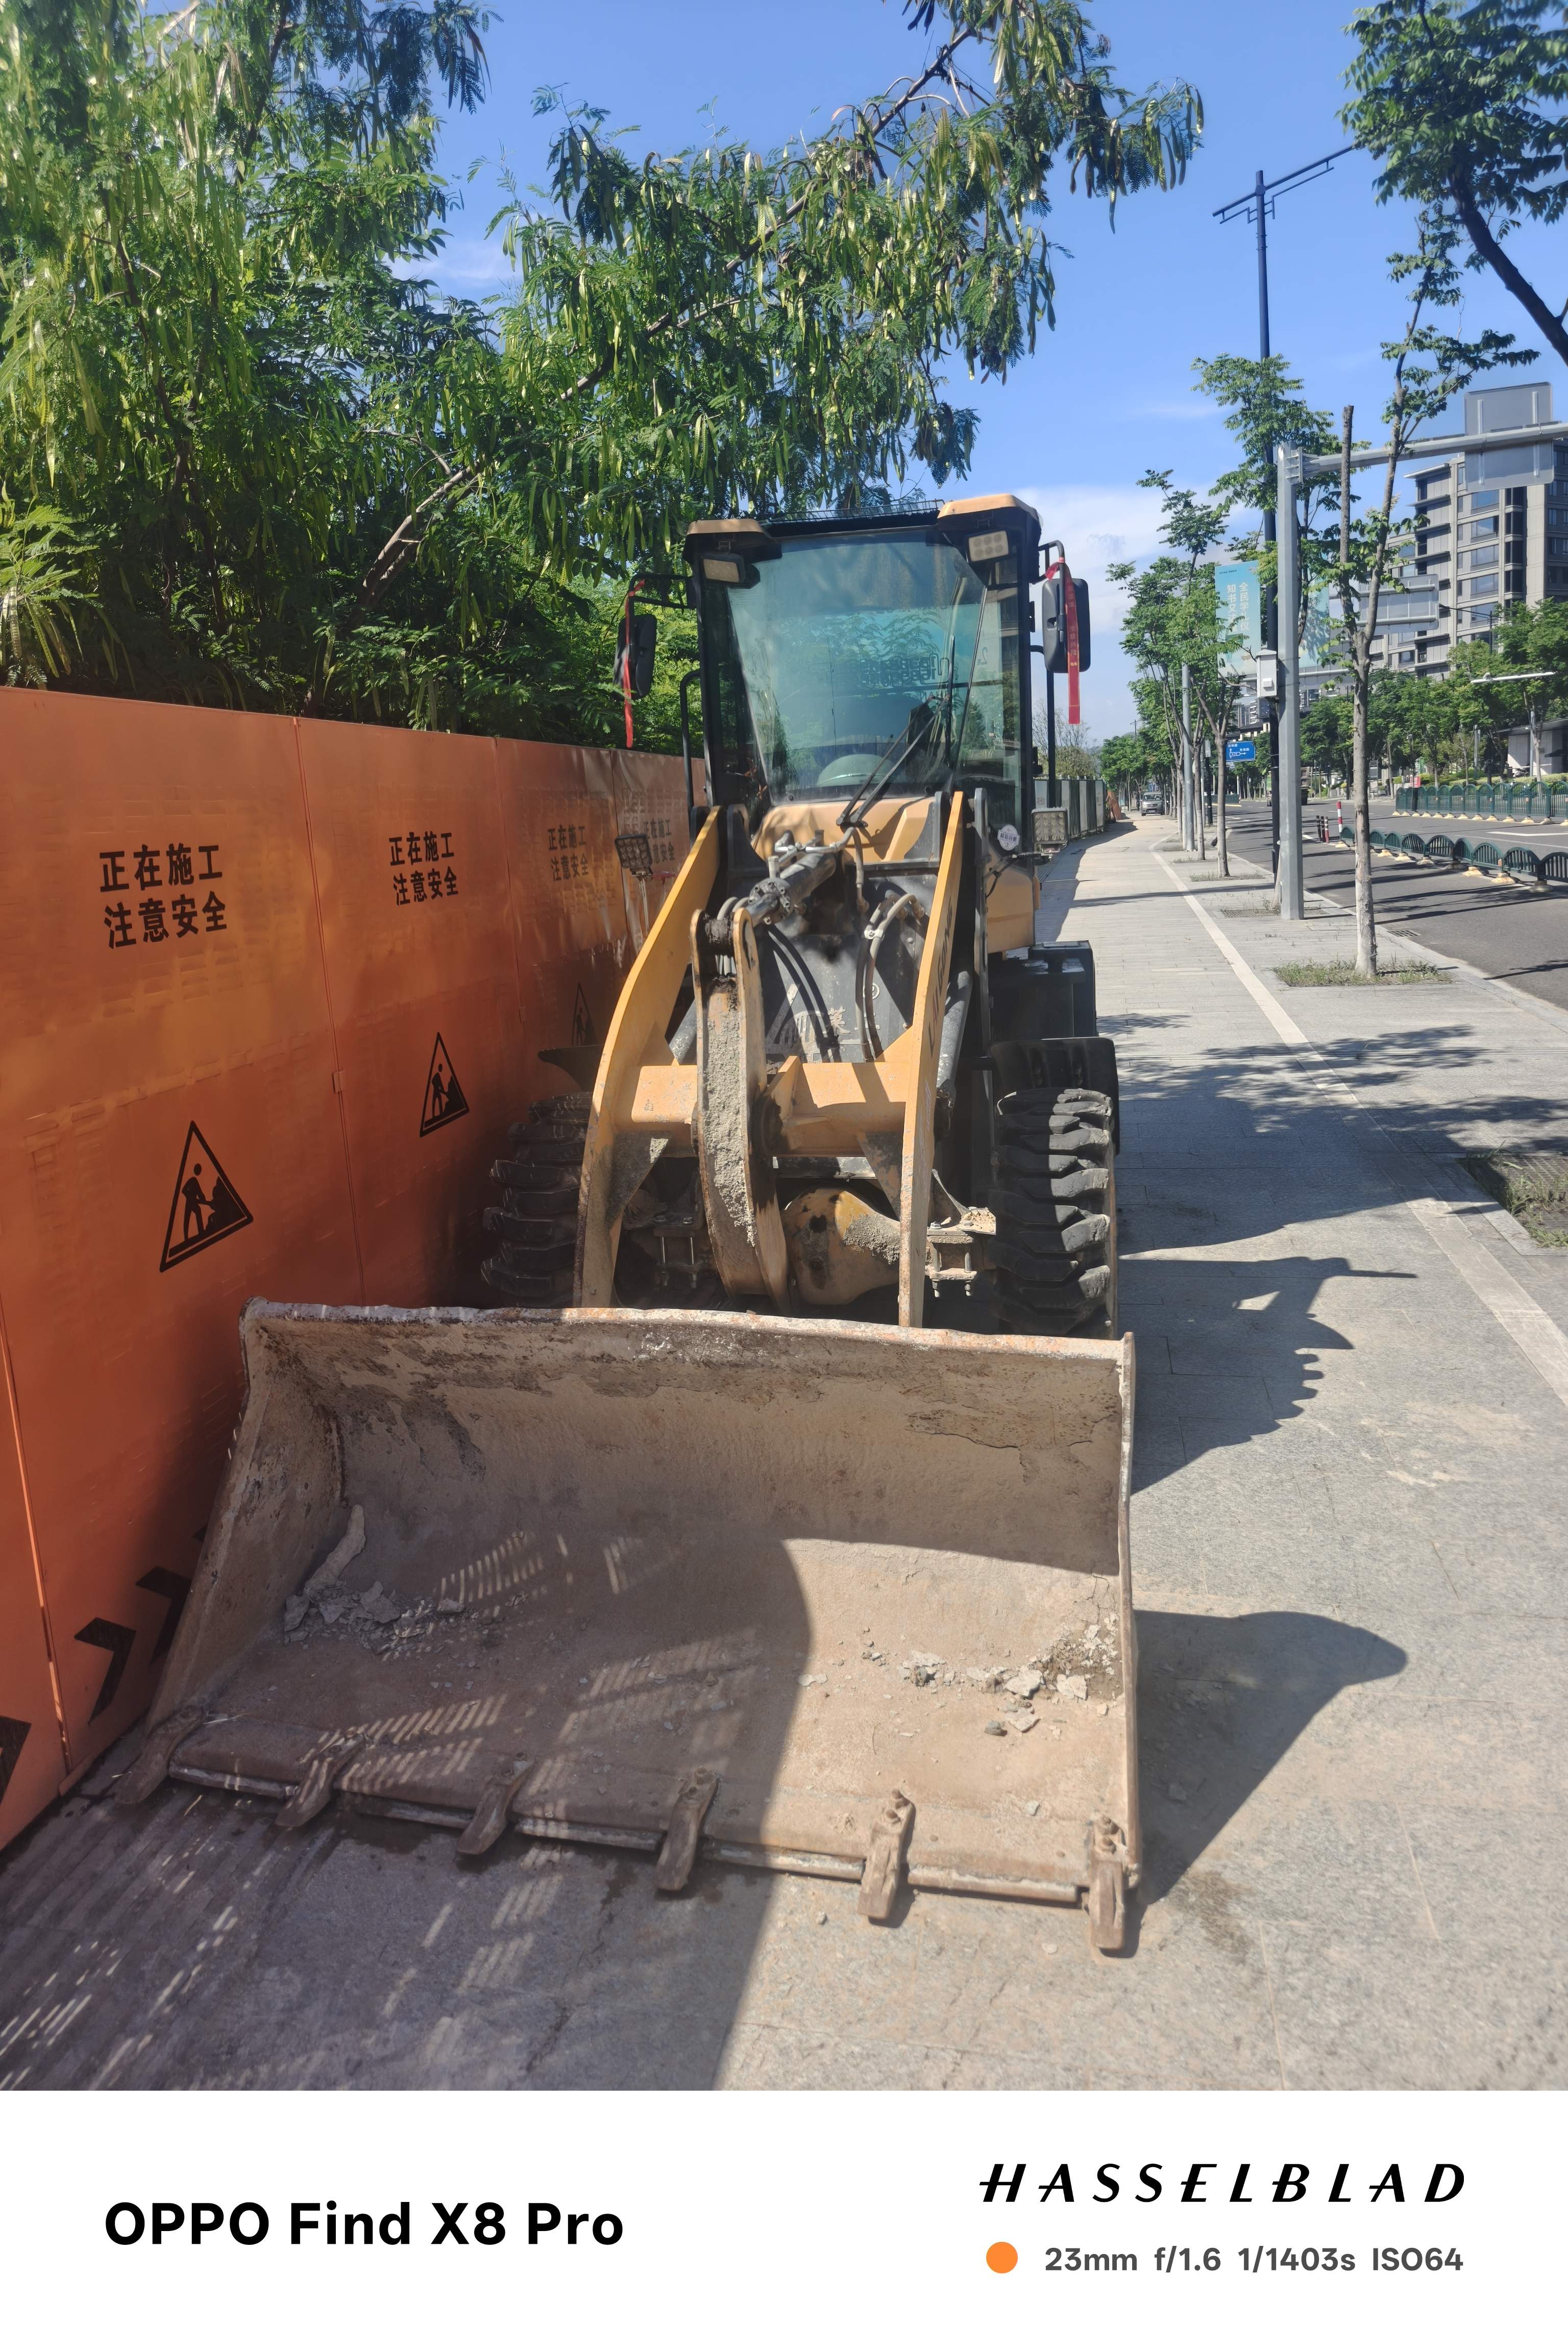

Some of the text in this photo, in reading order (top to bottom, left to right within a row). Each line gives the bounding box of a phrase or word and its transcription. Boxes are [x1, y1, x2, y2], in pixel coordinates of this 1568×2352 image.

[388, 831, 455, 867] 正在施工
[547, 824, 586, 851] 正在施工
[652, 841, 675, 864] 意安全
[99, 842, 223, 893] 正在施工
[551, 853, 589, 882] 注意安全
[393, 866, 459, 906] 注意安全
[104, 891, 228, 949] 注意安全
